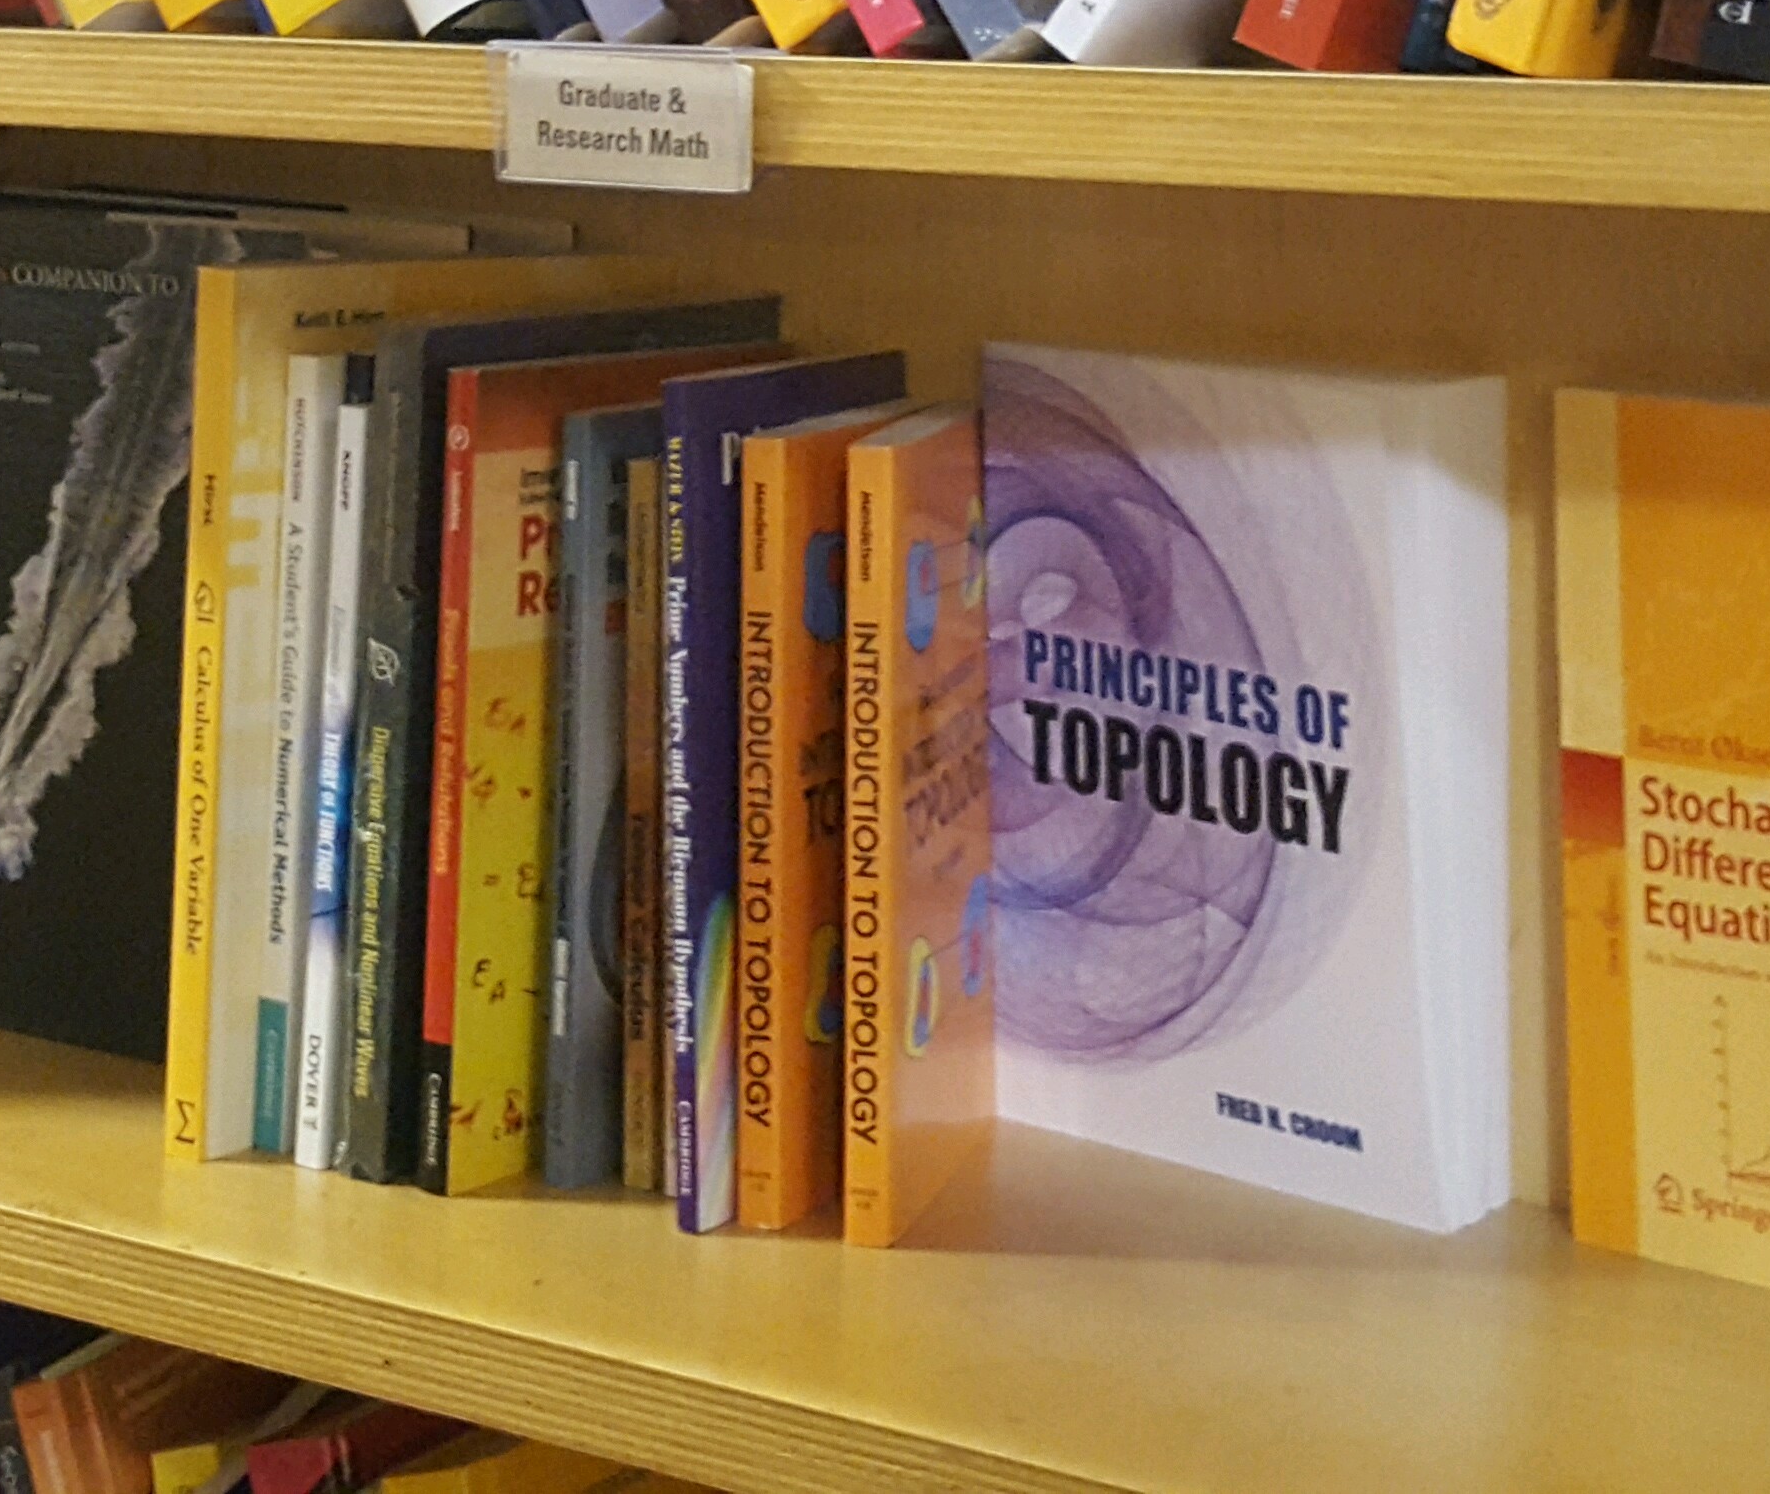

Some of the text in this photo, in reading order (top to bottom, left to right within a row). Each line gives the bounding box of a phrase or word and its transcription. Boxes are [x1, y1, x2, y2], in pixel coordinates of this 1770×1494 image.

[537, 120, 710, 159] Research Math
[558, 80, 687, 114] Graduate &
[11, 262, 142, 296] COMPANION
[269, 543, 303, 944] Student's Guide Numerical Methods
[1024, 628, 1350, 750] PRINCIPLES OF
[1023, 699, 1351, 855] TOPOLOGY
[745, 610, 774, 1127] INTRODUCTION TO TOPOLOGY
[851, 621, 879, 1145] INTRODUCTION TO TOPOLOGY
[1216, 1091, 1264, 1125] FRED
